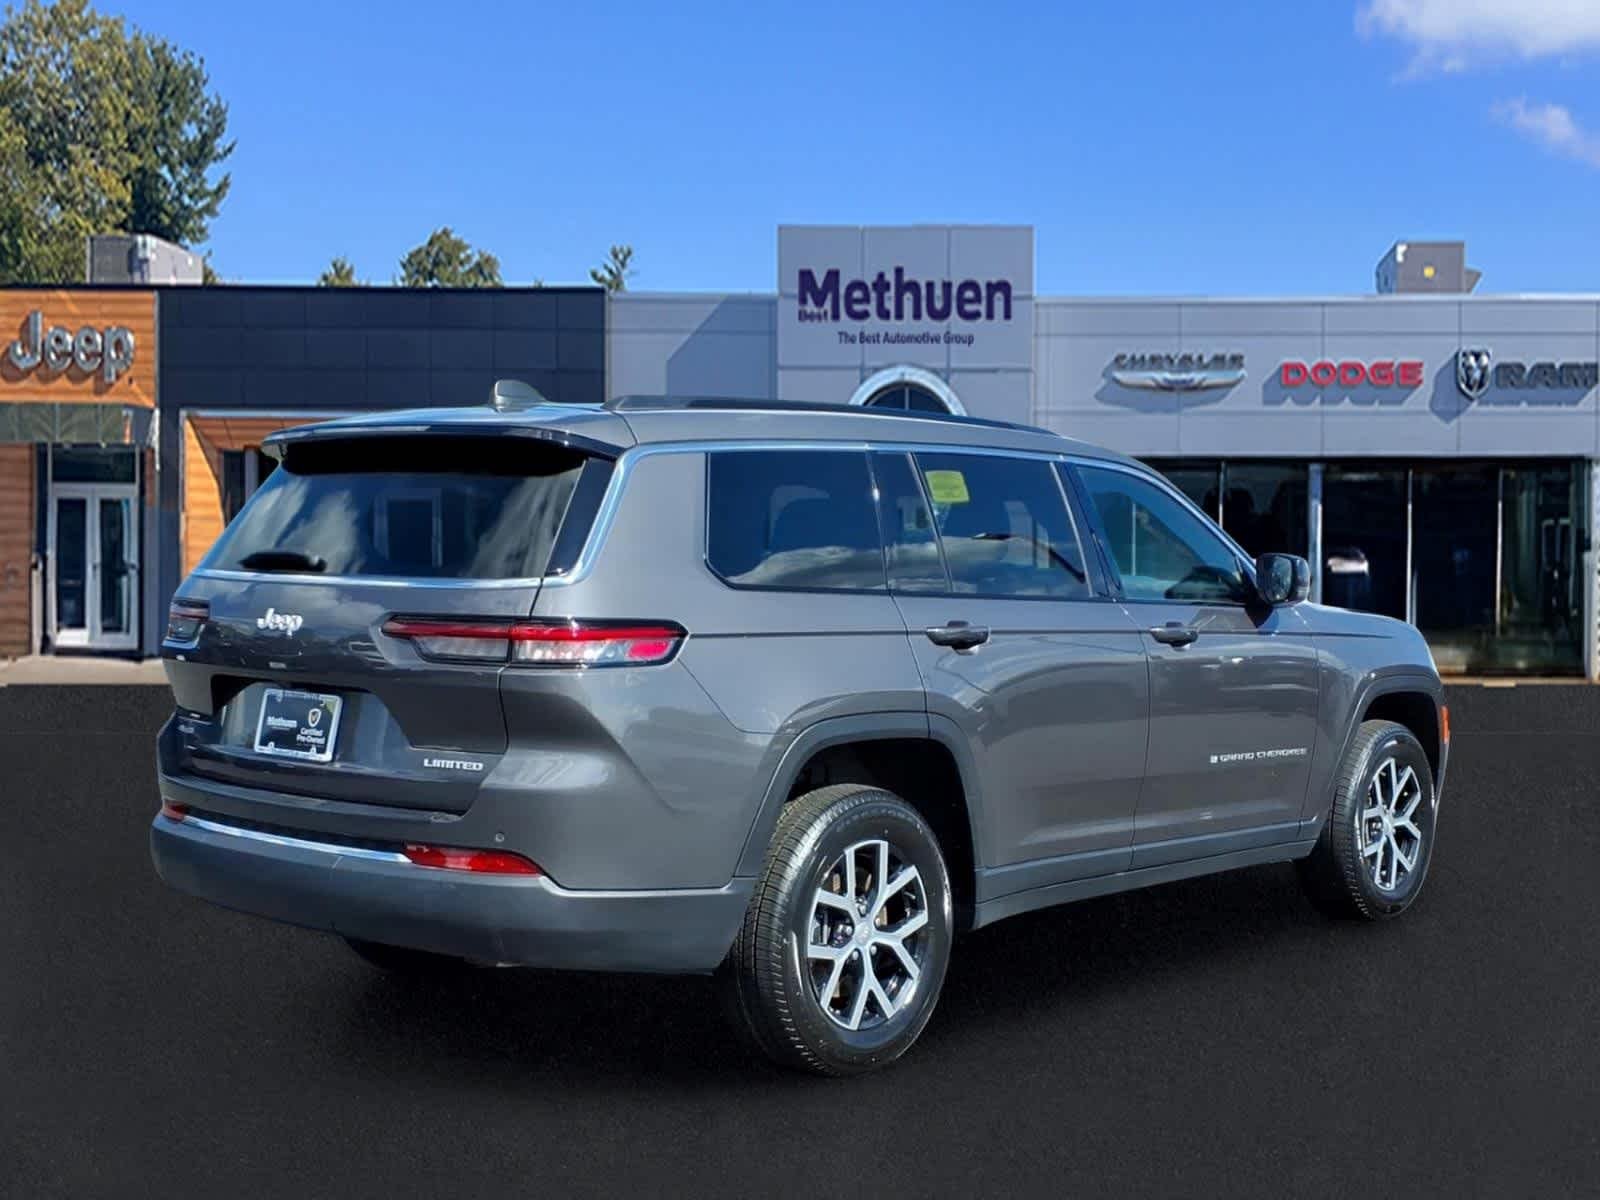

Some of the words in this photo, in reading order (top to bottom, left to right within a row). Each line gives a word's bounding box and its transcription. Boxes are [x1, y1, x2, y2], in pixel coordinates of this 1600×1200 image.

[798, 266, 1012, 321] Methuen
[798, 309, 829, 322] Best
[9, 310, 135, 384] Jeep
[838, 332, 856, 344] The
[859, 332, 880, 344] Best
[883, 332, 941, 344] Automotive
[943, 332, 974, 346] Group
[1112, 354, 1245, 368] CHRYSLER
[1280, 361, 1424, 387] DODGE
[1495, 362, 1599, 388] RAM
[256, 607, 303, 637] Jeep
[423, 758, 484, 771] LIMITED
[1220, 752, 1255, 762] GRAND
[1256, 747, 1307, 759] CHEROKEE
